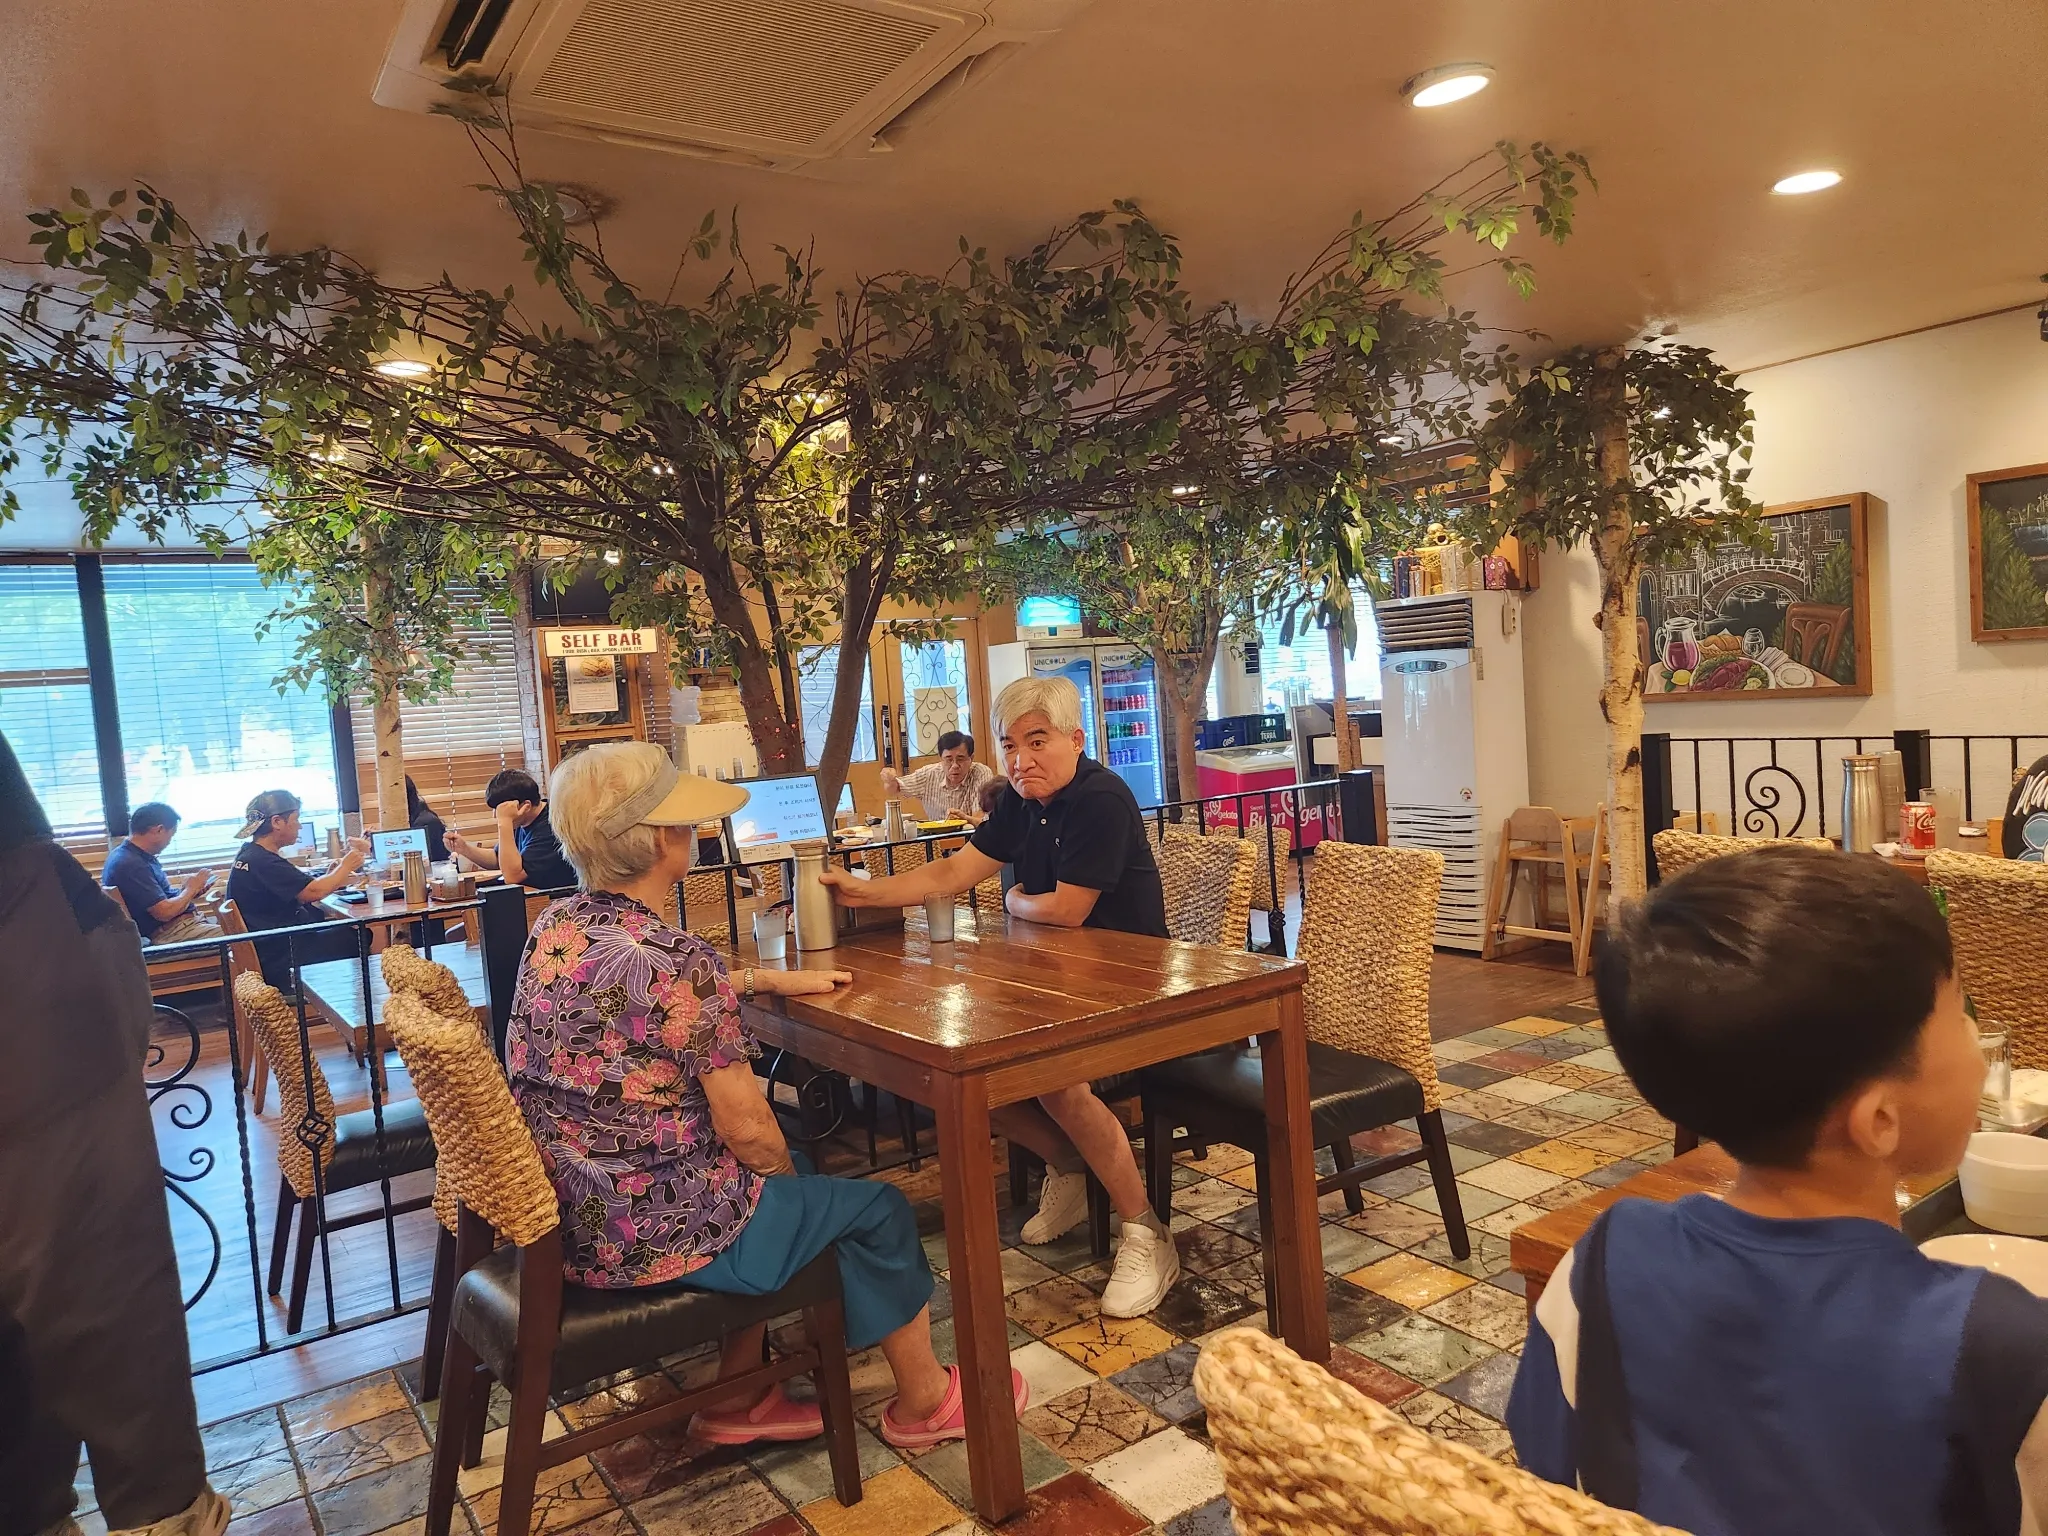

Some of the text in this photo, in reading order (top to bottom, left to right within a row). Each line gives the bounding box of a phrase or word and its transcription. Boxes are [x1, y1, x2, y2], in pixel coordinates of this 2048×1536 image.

[561, 633, 642, 648] SELF BAR
[1260, 730, 1276, 740] TERRA
